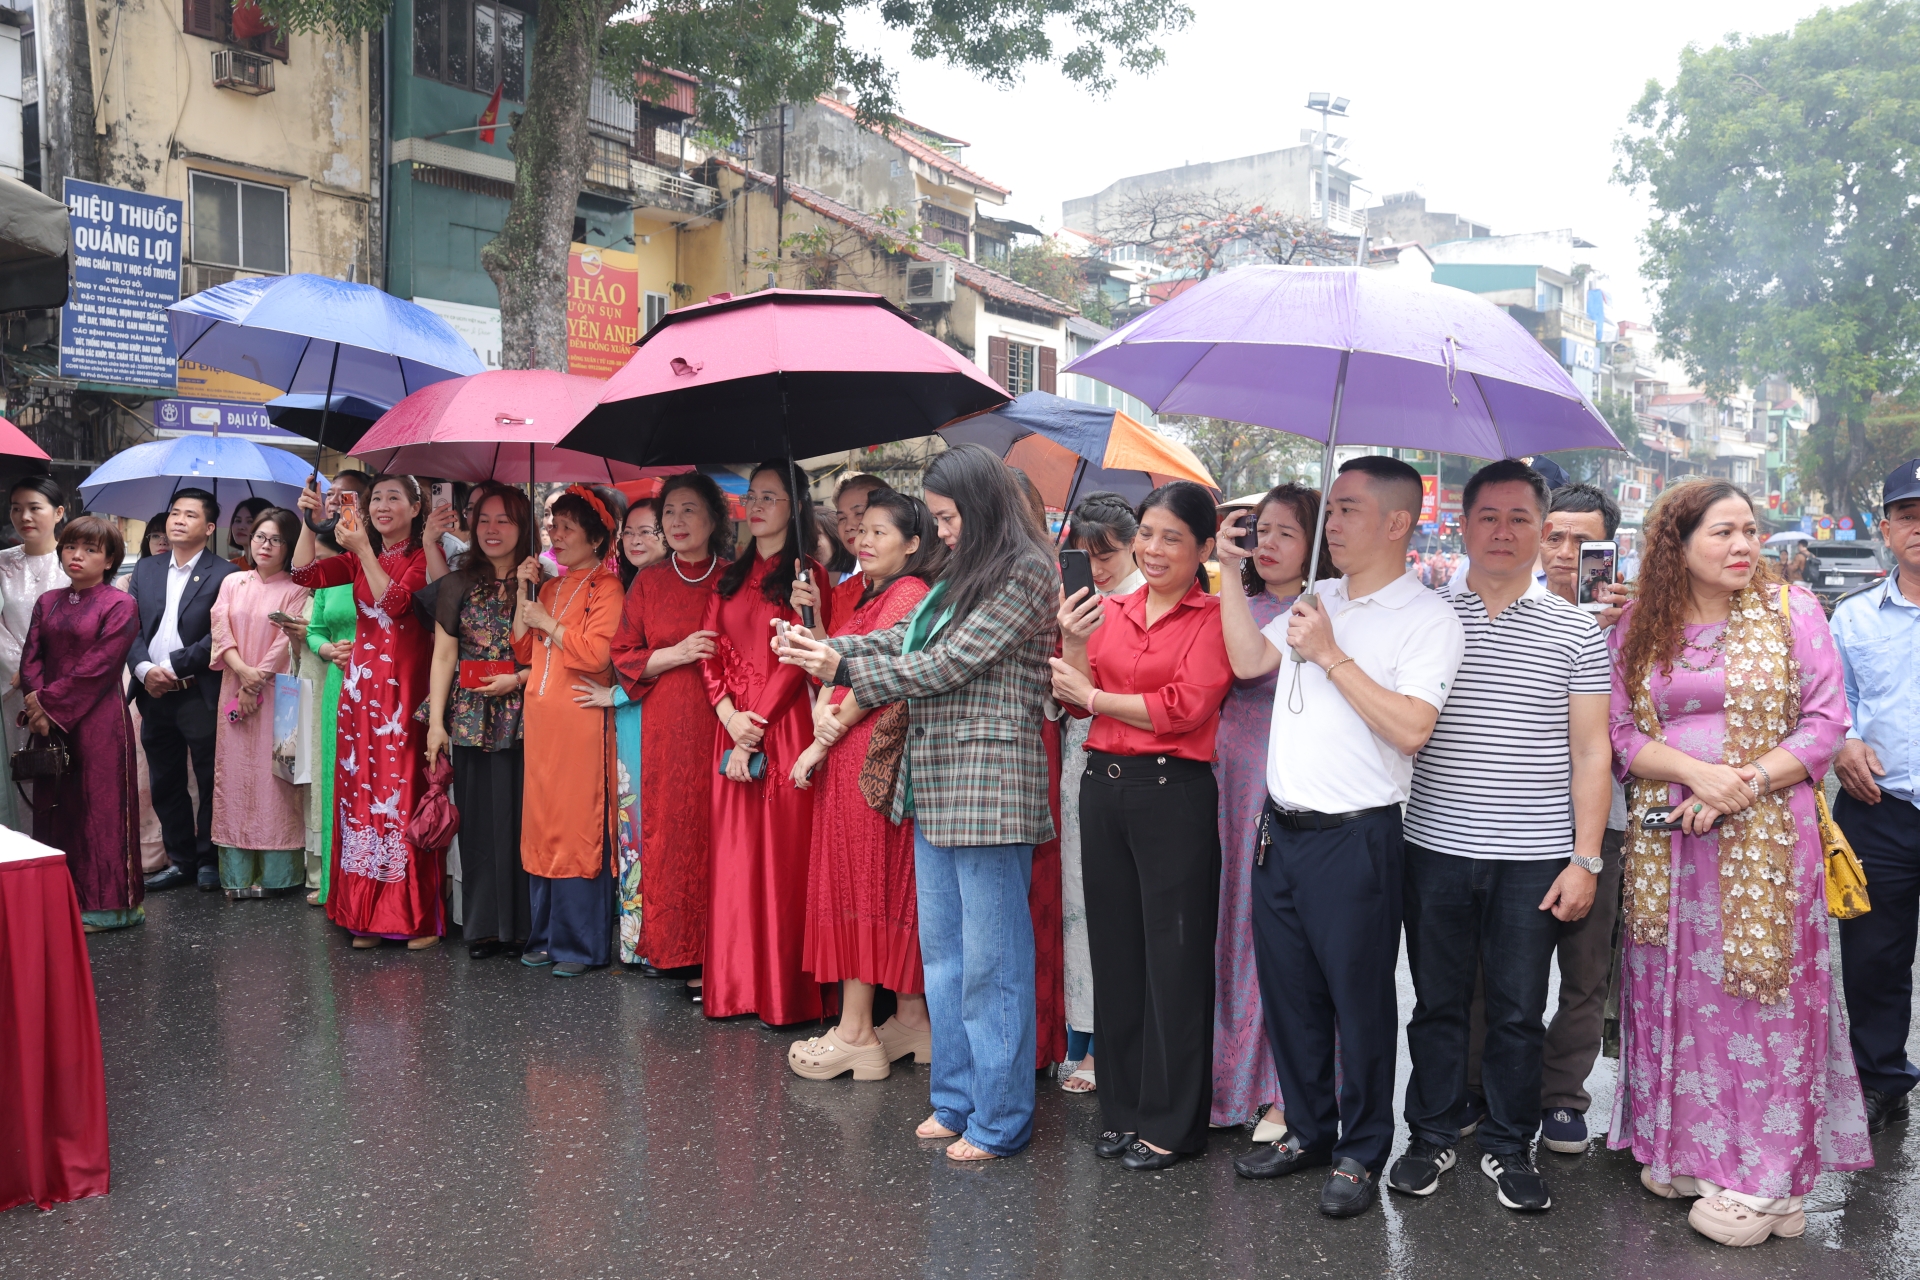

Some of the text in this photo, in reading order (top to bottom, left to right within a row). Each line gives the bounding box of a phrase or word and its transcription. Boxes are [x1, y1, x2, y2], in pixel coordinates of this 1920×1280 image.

[70, 194, 177, 233] HIỆU THUỐC
[75, 225, 172, 264] QUẢNG LỢI
[123, 263, 129, 274] Y
[129, 264, 141, 277] HỌC
[105, 276, 119, 284] CHỦ
[69, 280, 91, 289] LƠNG
[159, 293, 173, 301] NINH
[97, 295, 105, 303] TRỊ
[568, 300, 622, 320] ƯỜN SỤN
[72, 326, 87, 334] CÁC
[89, 328, 105, 337] BỆNH
[107, 331, 129, 339] PHONG
[131, 333, 144, 341] HÀN
[127, 321, 137, 330] GAN
[567, 314, 637, 344] YỀN ANH
[569, 338, 587, 350] ĐÊM
[588, 340, 610, 353] ĐỒNG
[610, 343, 631, 355] XUÂN
[227, 411, 279, 430] ĐẠI LÝ DỊ
